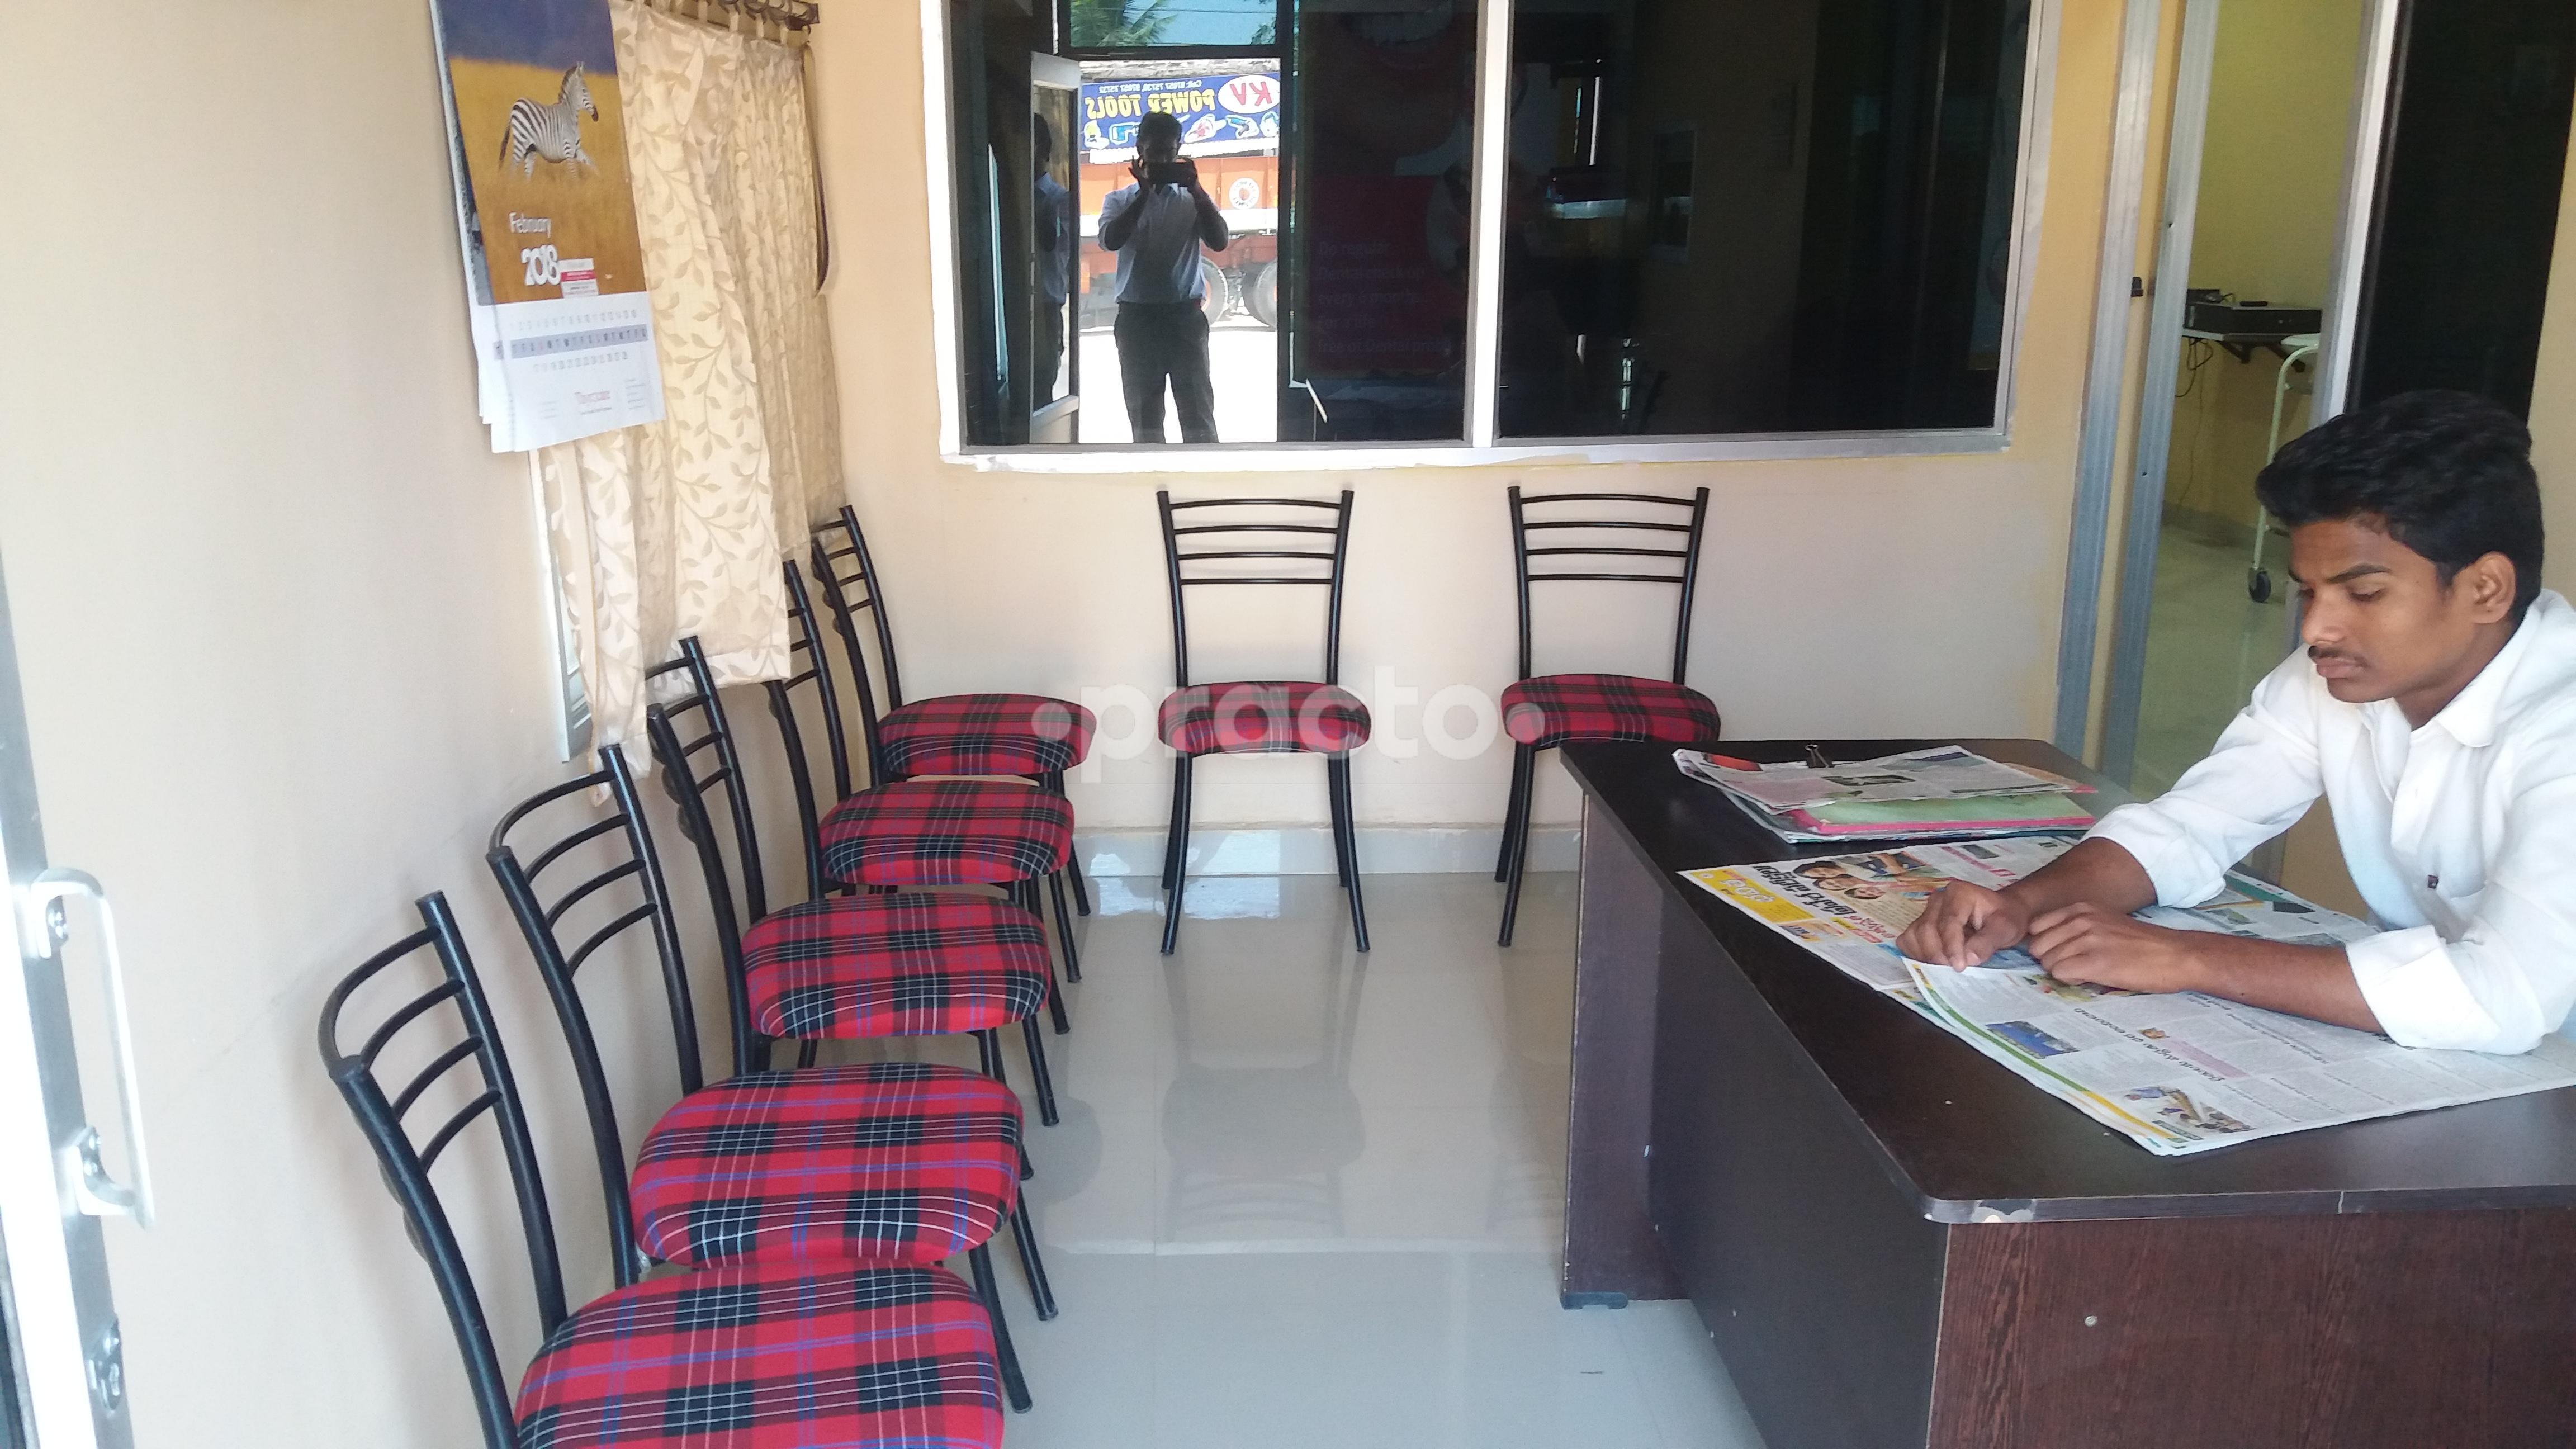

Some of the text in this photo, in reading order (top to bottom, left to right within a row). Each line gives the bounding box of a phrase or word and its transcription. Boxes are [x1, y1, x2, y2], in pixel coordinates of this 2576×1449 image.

[509, 211, 552, 238] February
[1342, 242, 1391, 259] regular
[521, 244, 561, 286] 2018
[1318, 293, 1353, 307] every
[1753, 866, 1811, 893] పరీక్షలు
